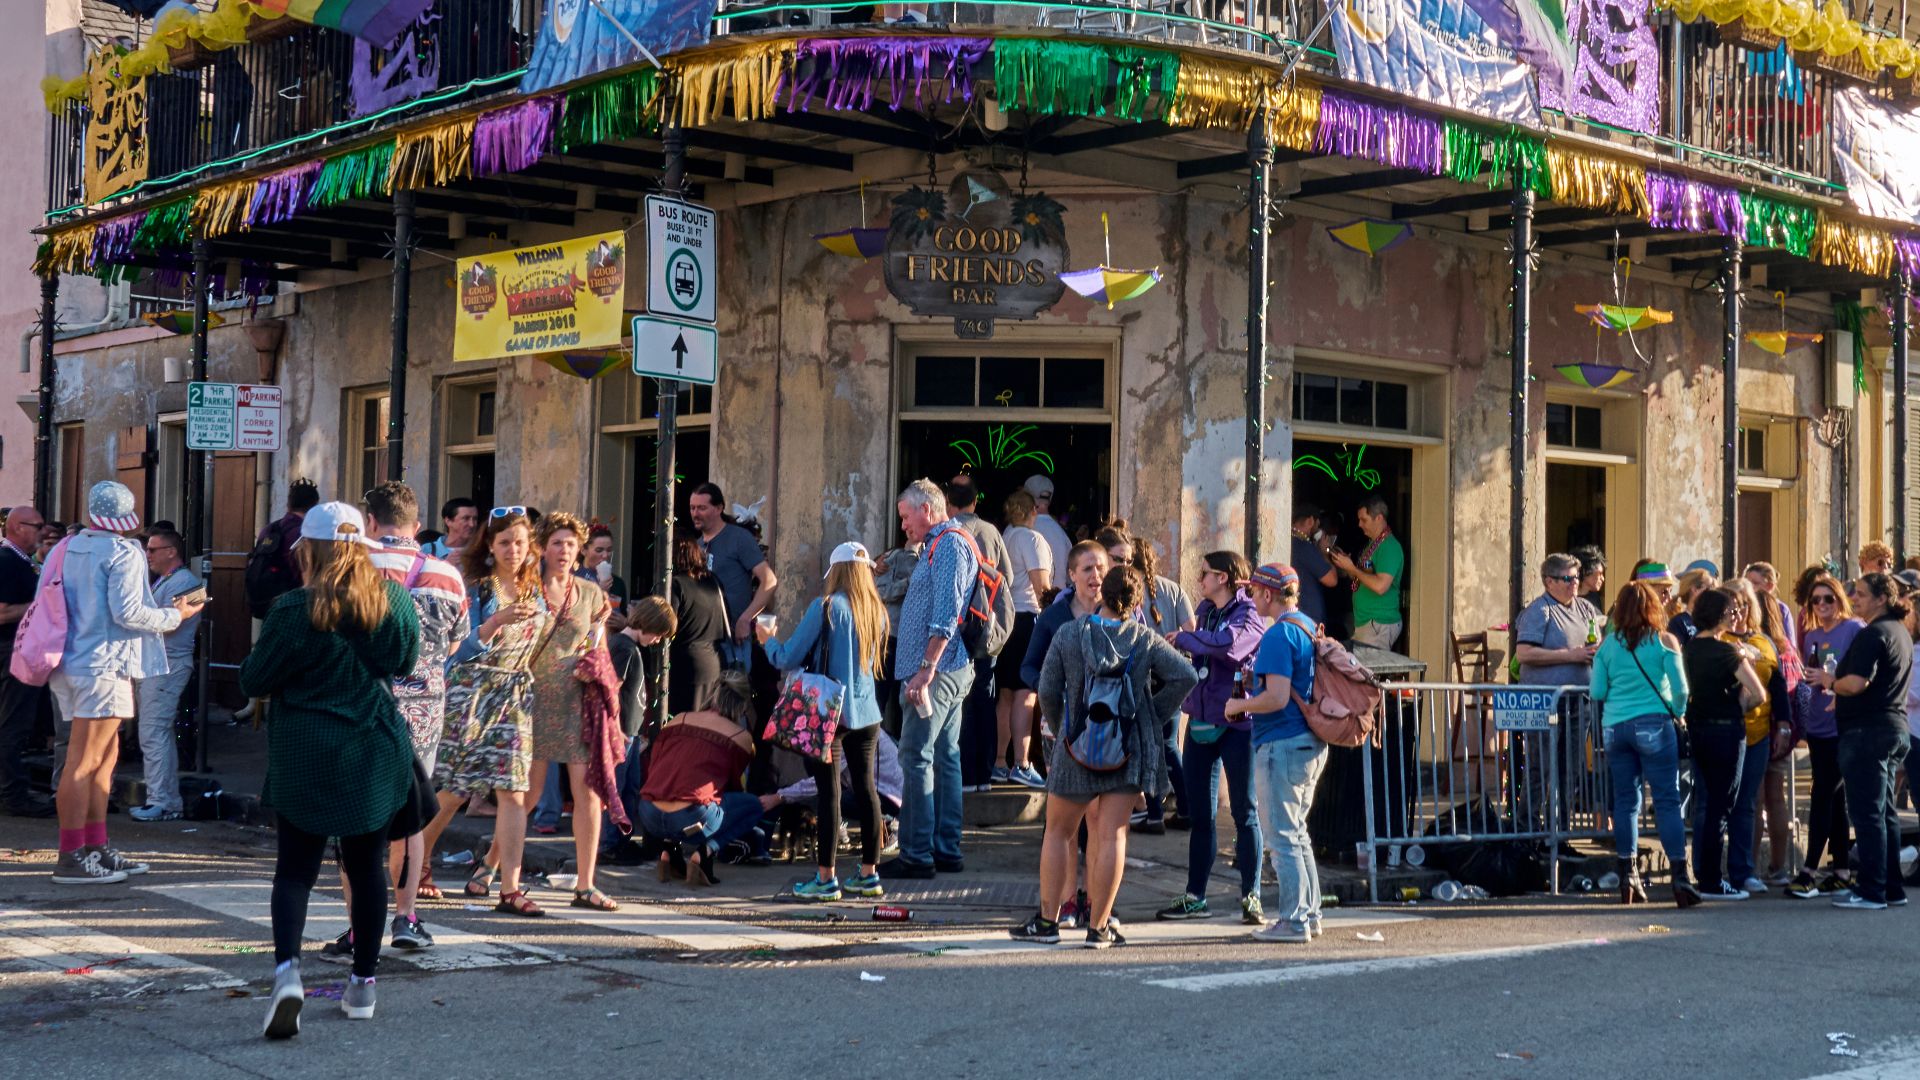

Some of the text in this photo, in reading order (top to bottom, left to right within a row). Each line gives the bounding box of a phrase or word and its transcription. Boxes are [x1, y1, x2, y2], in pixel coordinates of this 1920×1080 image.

[658, 205, 708, 228] BUS ROUTE
[666, 221, 685, 233] BUSES
[695, 228, 702, 237] FT
[666, 233, 703, 248] AND UNDER
[934, 225, 1022, 256] GOOD
[513, 245, 565, 267] WELCOME
[593, 265, 617, 277] GOOD
[907, 254, 1046, 287] FRIENDS
[590, 275, 621, 288] FRIENDS
[468, 285, 490, 296] GOOD
[952, 287, 998, 306] BAR
[463, 293, 495, 306] FRIENDS
[513, 313, 576, 335] BARKUS 2018
[506, 331, 581, 352] GAME OF BONES
[190, 387, 201, 404] 2
[212, 387, 225, 396] HR
[238, 390, 281, 403] NO PARKING
[204, 397, 232, 406] PARKING
[244, 419, 274, 427] CORNER
[242, 438, 274, 446] ANYTIME
[1505, 712, 1546, 720] POLICE LINE
